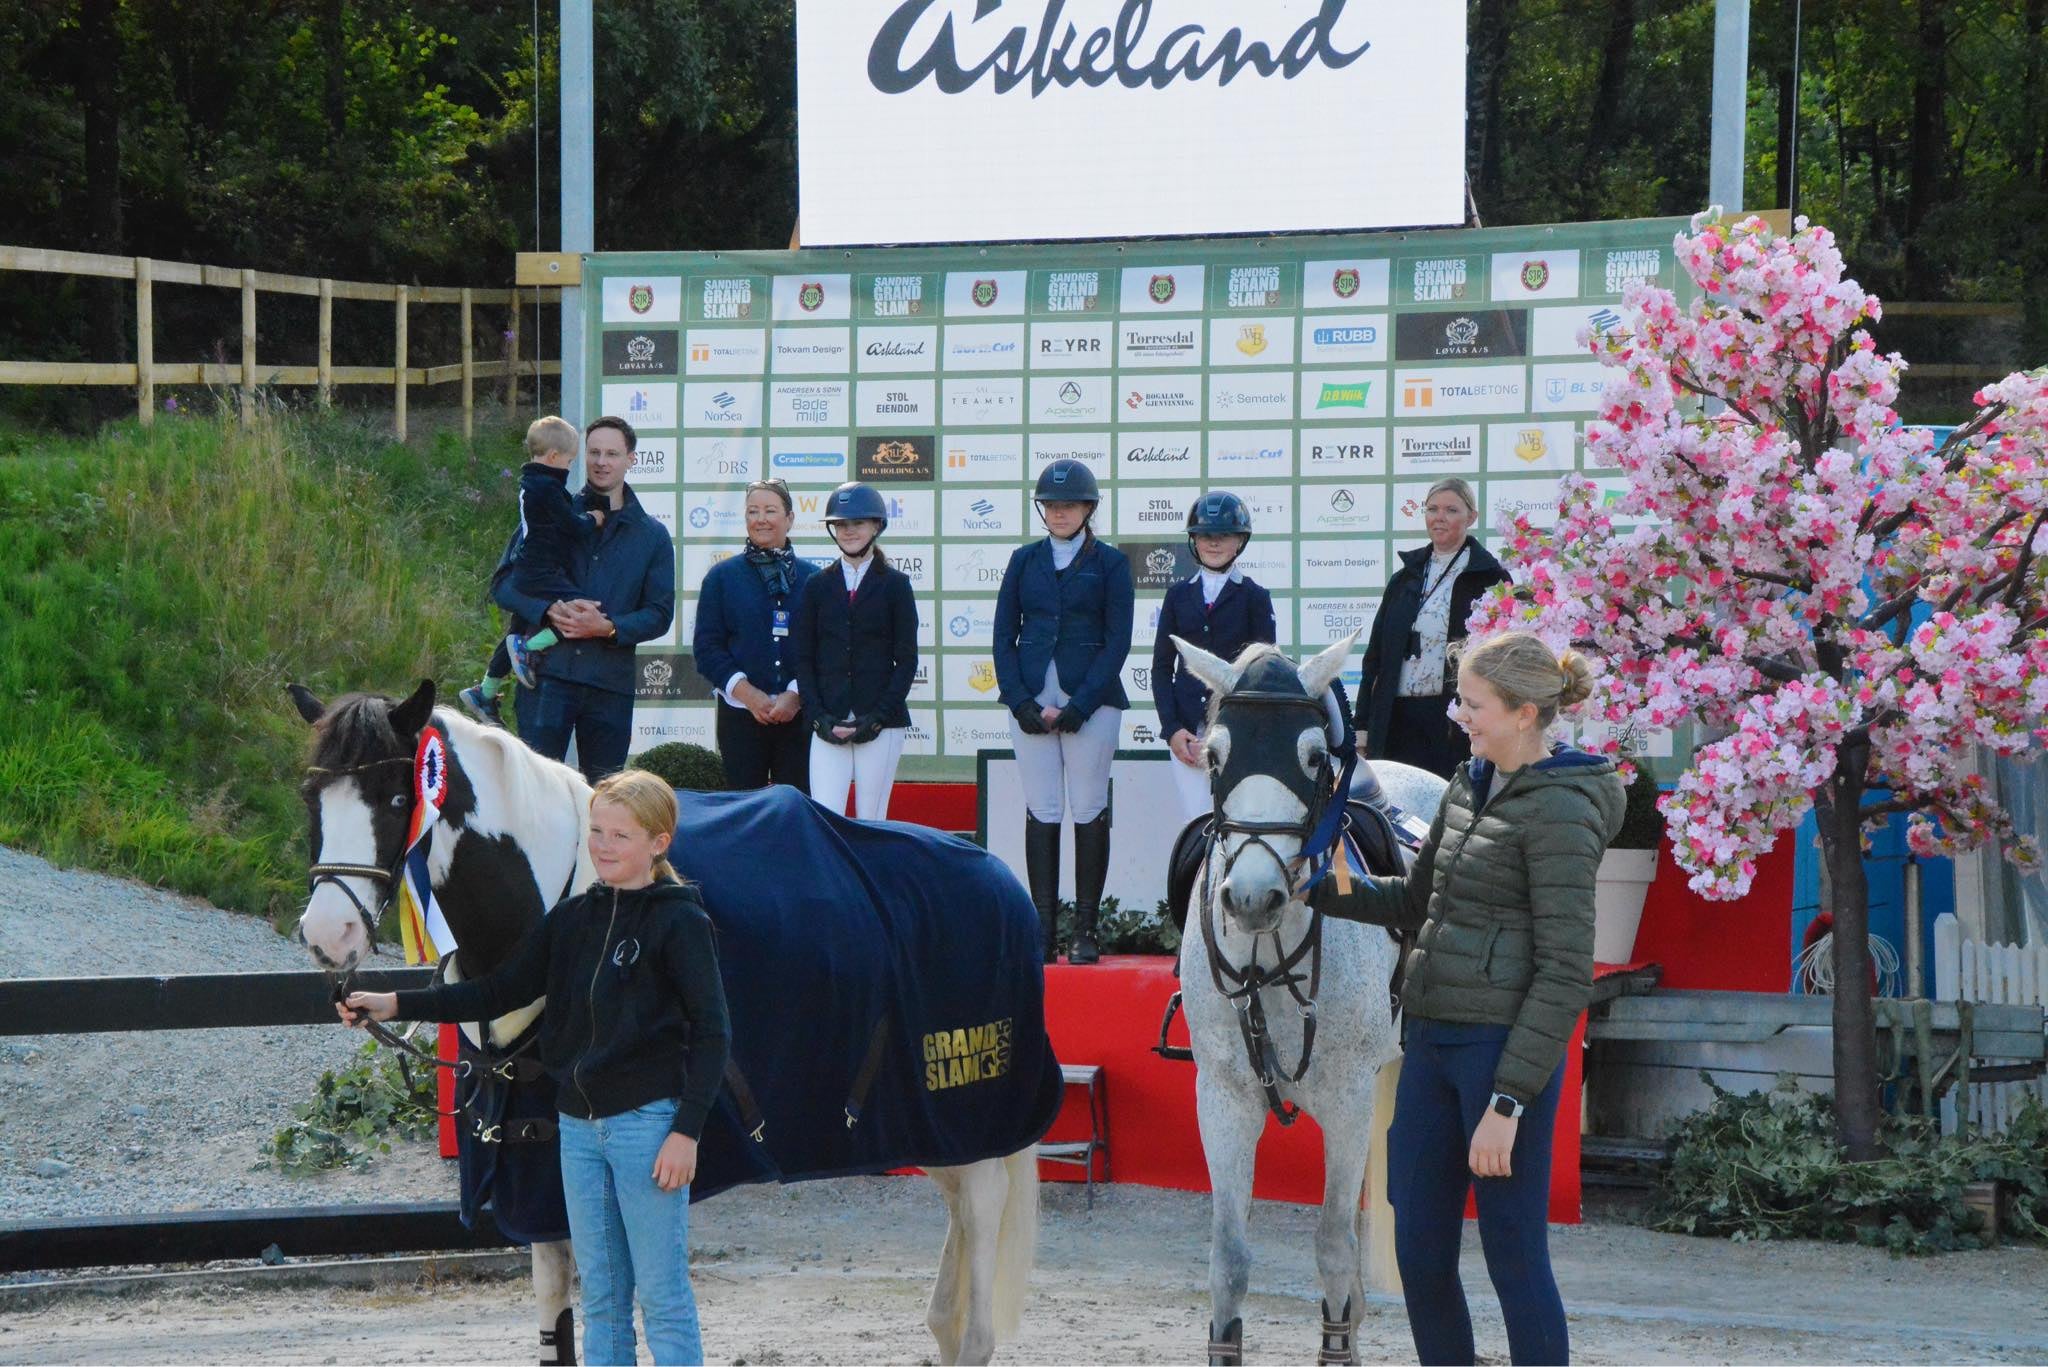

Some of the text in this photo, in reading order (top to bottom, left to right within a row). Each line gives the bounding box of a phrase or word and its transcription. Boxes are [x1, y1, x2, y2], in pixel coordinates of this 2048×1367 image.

[1606, 249, 1660, 262] SANDNES
[1415, 259, 1466, 271] SANDNES
[1605, 260, 1660, 277] GRAND
[1049, 272, 1099, 283] SANDNES
[1230, 266, 1280, 278] SANDNES
[1414, 269, 1467, 285] GRAND
[704, 279, 751, 290] SANDNES
[874, 276, 922, 287] SANDNES
[1228, 276, 1280, 292] GRAND
[874, 285, 922, 300] GRAND
[1048, 281, 1099, 297] GRAND
[1414, 285, 1451, 301] SLAM
[704, 289, 751, 304] GRAND
[1228, 291, 1266, 307] SLAM
[874, 300, 909, 316] SLAM
[1048, 296, 1084, 312] SLAM
[704, 303, 738, 319] SLAM
[1126, 331, 1194, 345] Torresdal
[1332, 329, 1373, 342] RUBB
[777, 345, 842, 355] Tokvam Design
[866, 340, 925, 358] Askeland
[886, 392, 909, 402] STOL
[952, 396, 1015, 405] TEAMET
[1145, 392, 1184, 400] ROGALAND
[792, 398, 828, 411] Bade
[876, 404, 918, 413] EIENDOM
[1145, 399, 1194, 407] GJENVINNING
[704, 410, 743, 421] NorSea
[1401, 436, 1471, 451] Torresdal
[1035, 451, 1102, 460] Tokvam Design
[1127, 446, 1191, 462] Askeland
[718, 460, 748, 475] DRS
[880, 467, 914, 475] HOLDING
[1148, 499, 1173, 510] STOL
[1253, 505, 1284, 513] MET
[1138, 511, 1184, 522] EIENDOM
[963, 518, 1002, 530] NorSea
[1306, 558, 1376, 568] Tokvam Design
[1323, 614, 1362, 627] Bade
[666, 687, 681, 695] A/S
[639, 726, 706, 736] TOTALBETONG
[922, 1022, 997, 1063] GRAND
[926, 1054, 980, 1092] SLAM
